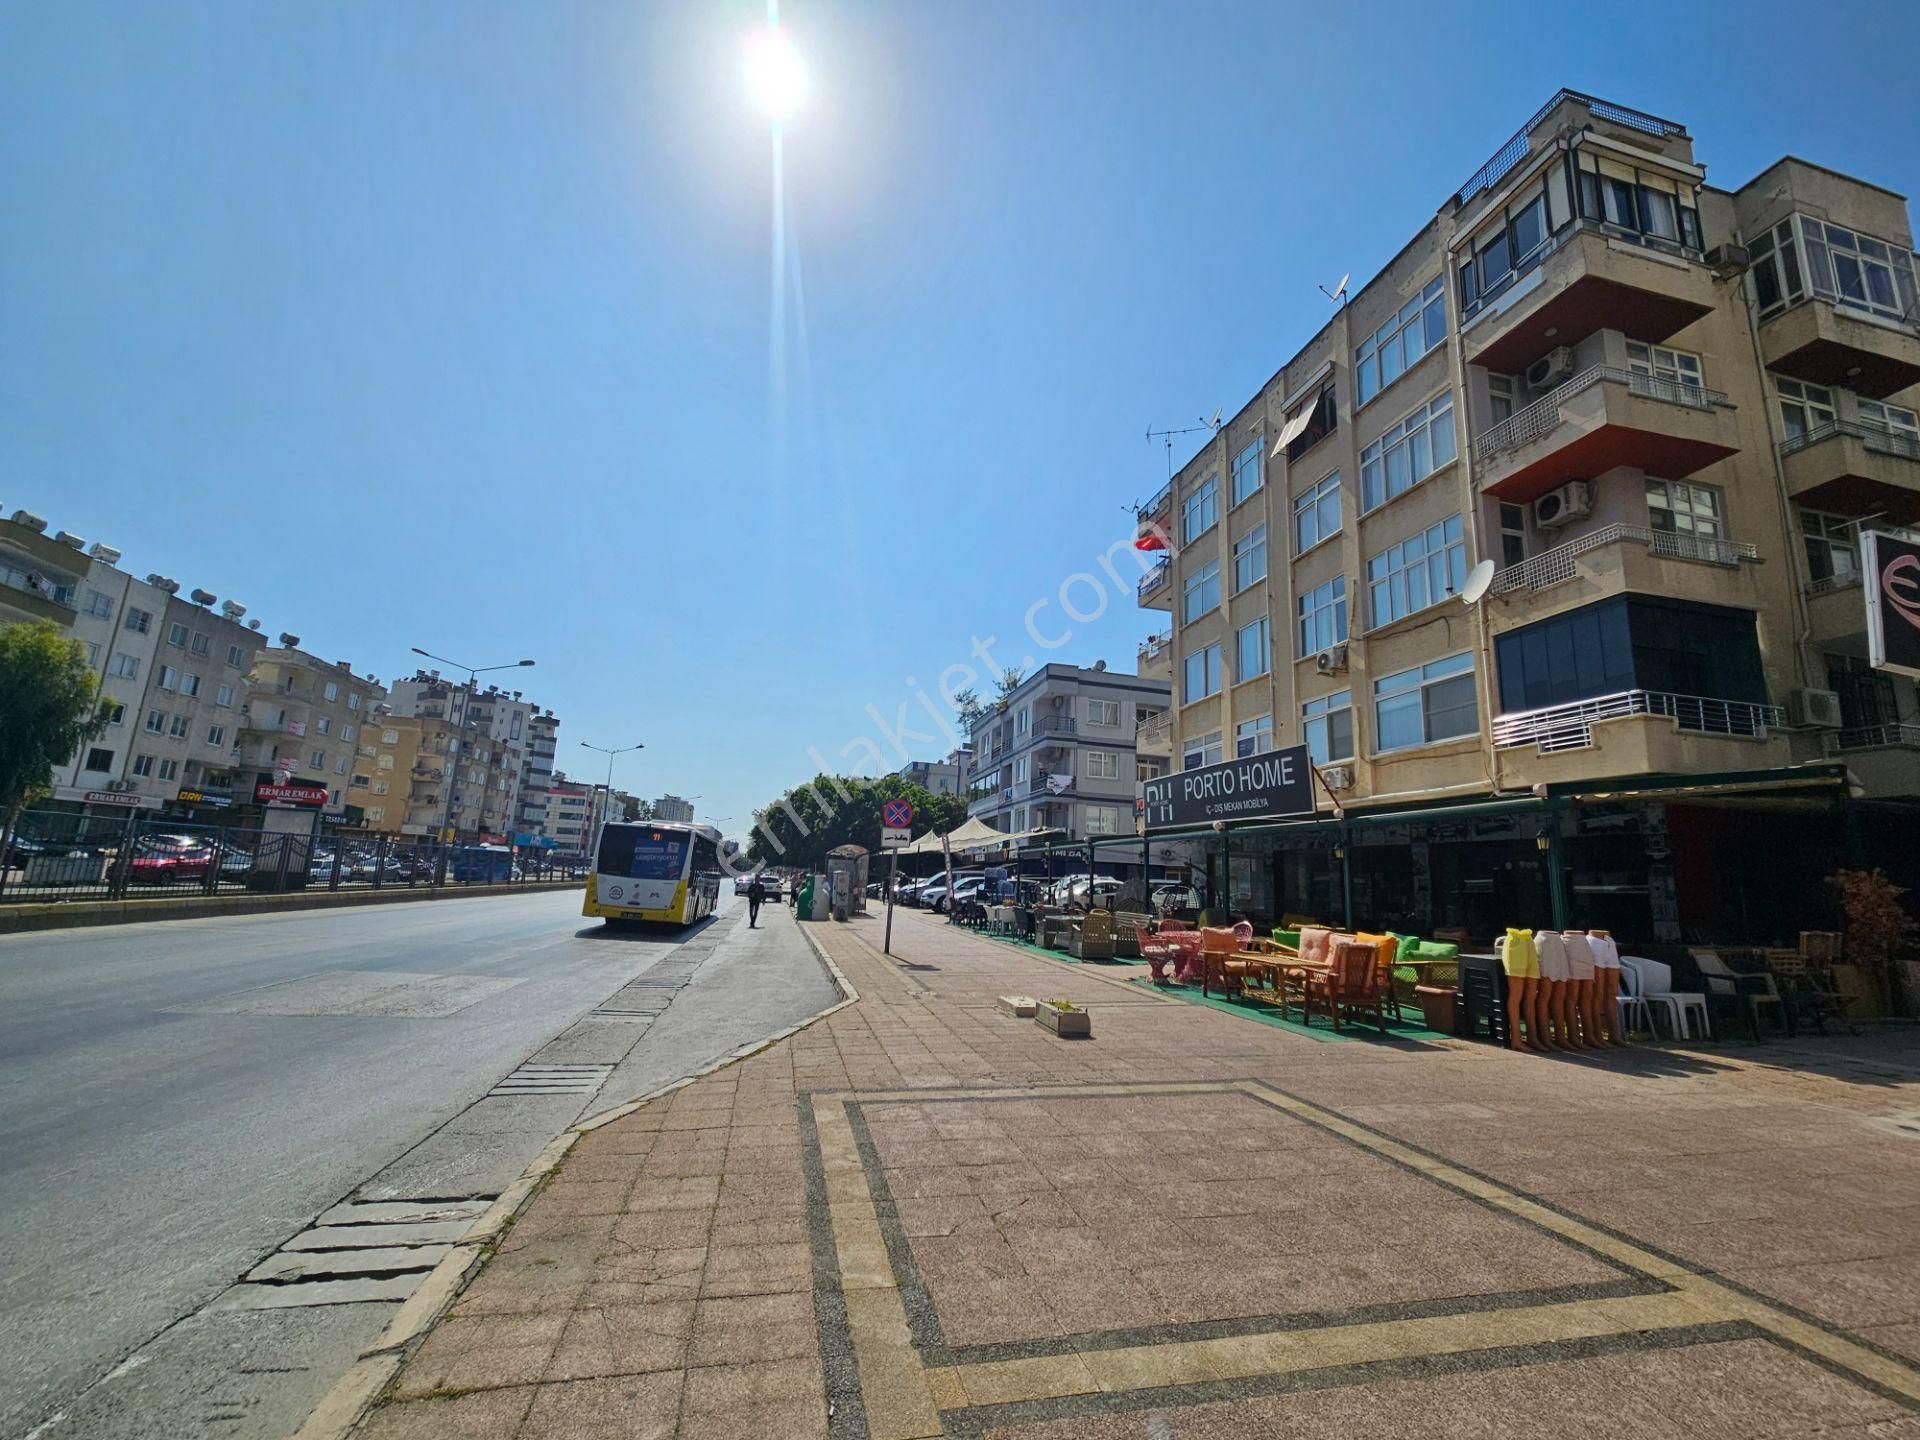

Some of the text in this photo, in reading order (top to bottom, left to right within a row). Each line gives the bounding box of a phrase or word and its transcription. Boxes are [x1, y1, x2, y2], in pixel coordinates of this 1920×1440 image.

[1184, 756, 1296, 801] PORTO HOME
[259, 787, 291, 797] ERMAR
[292, 791, 323, 800] EMLAK
[1224, 800, 1243, 812] MEKAN
[1243, 797, 1269, 809] MOBİLYA
